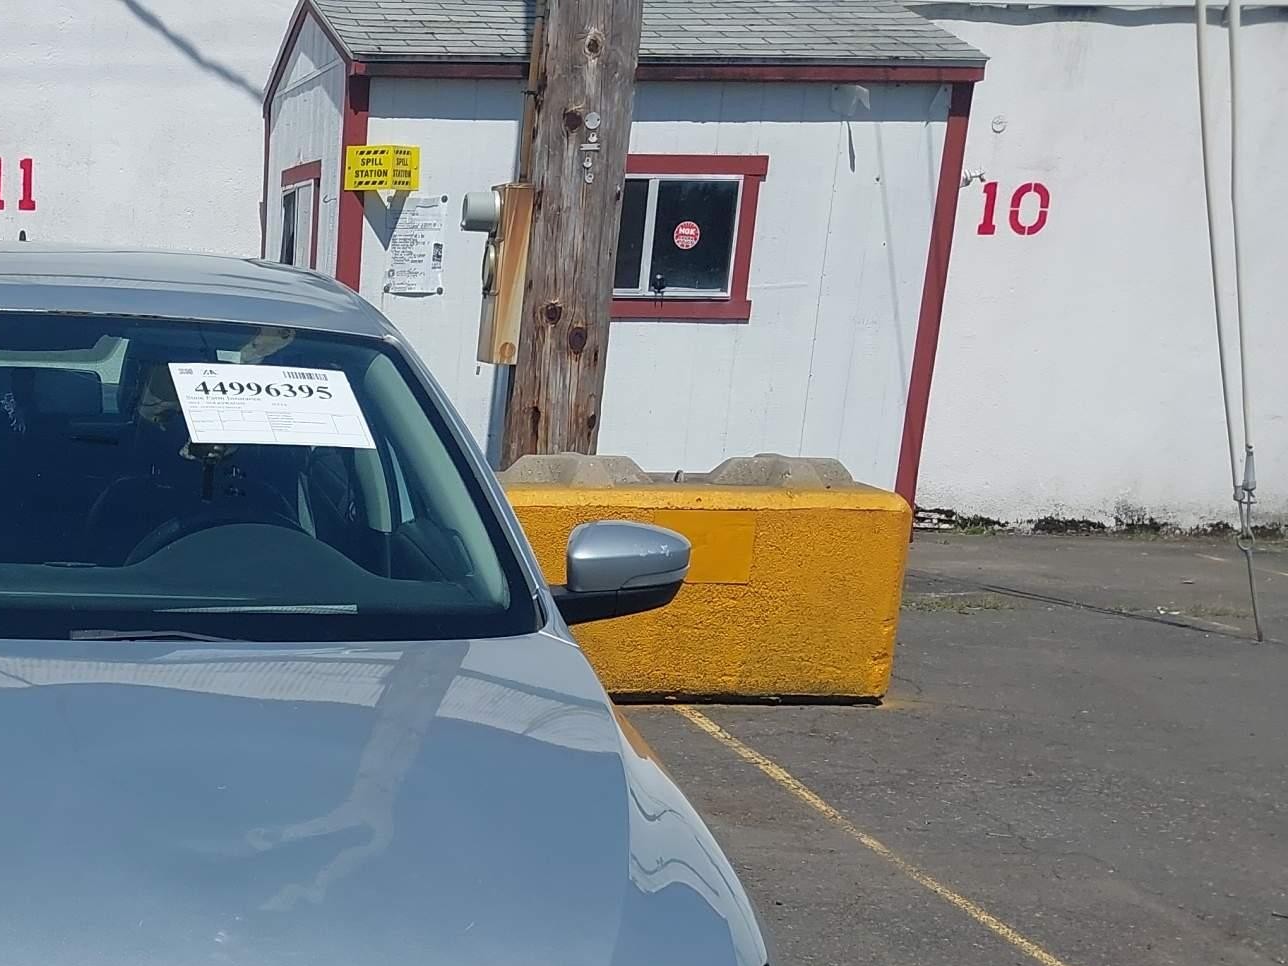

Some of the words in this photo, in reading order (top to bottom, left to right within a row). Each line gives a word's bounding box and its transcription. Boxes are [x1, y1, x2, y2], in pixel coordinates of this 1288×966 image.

[360, 157, 383, 167] SPILL
[354, 169, 389, 178] STATION
[977, 181, 1050, 236] 10
[194, 380, 333, 400] 44996395
